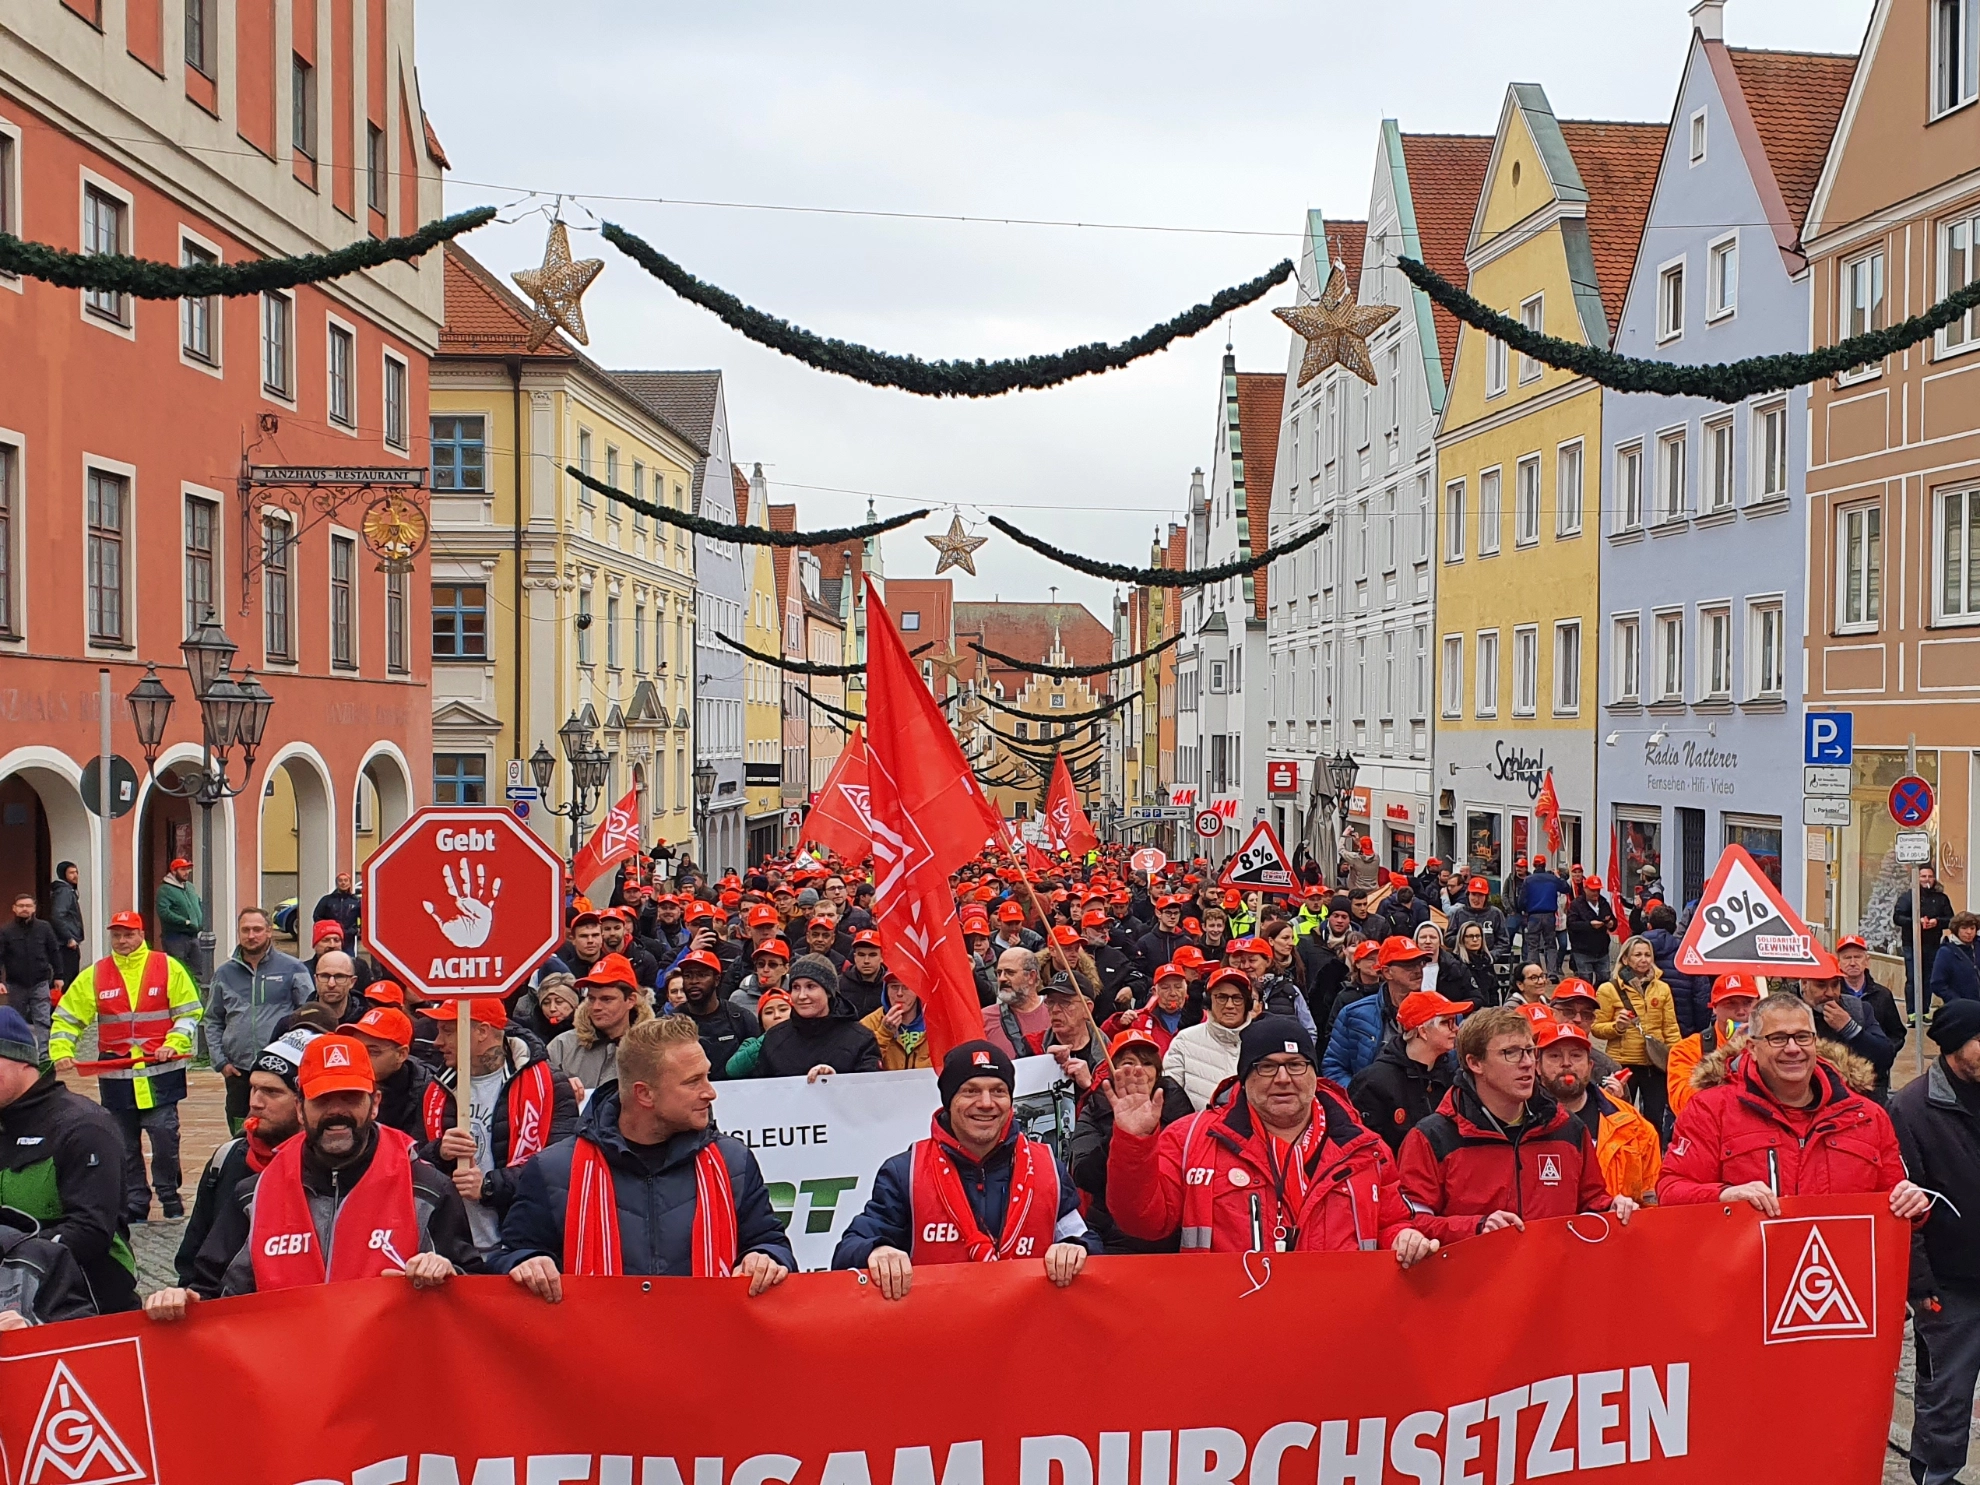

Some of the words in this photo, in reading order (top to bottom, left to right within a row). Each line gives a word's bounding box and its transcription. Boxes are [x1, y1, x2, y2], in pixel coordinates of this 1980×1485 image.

[263, 470, 326, 480] TANZHAUS
[335, 471, 410, 481] RESTAURANT
[1811, 718, 1838, 758] P
[1645, 742, 1679, 766] Radio
[1683, 740, 1738, 768] Natterer
[1647, 775, 1685, 791] Fernsehen
[1692, 777, 1705, 792] Hifi
[1711, 778, 1735, 795] Video
[1201, 817, 1217, 830] 30
[435, 827, 496, 851] Gebt
[1239, 845, 1273, 870] 8%
[1705, 889, 1769, 938] 8%
[1757, 936, 1800, 944] SOLIDARITÄT
[428, 957, 490, 979] ACHT
[99, 988, 121, 1000] GEBT
[723, 1124, 828, 1149] SLEUTE
[923, 1222, 965, 1243] GEB
[263, 1232, 312, 1256] GEBT
[1015, 1236, 1035, 1256] 8!
